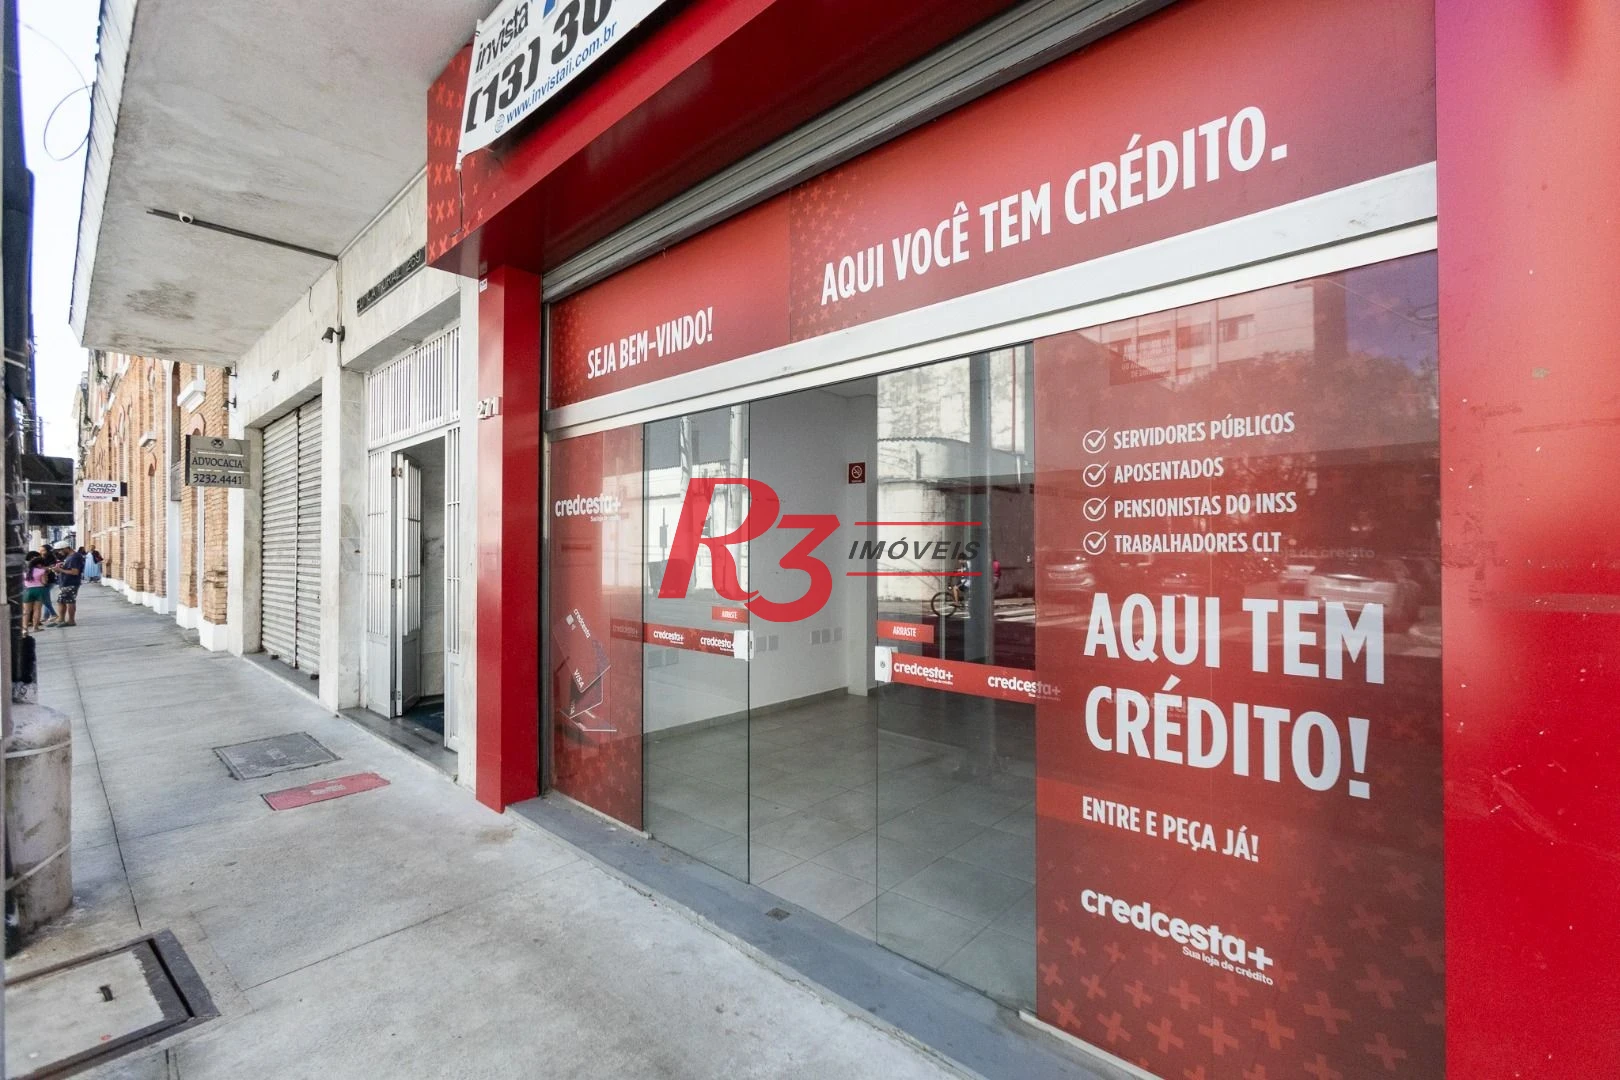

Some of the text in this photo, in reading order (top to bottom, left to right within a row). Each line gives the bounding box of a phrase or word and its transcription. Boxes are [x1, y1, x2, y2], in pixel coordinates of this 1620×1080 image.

[475, 1, 529, 74] invista
[820, 105, 1288, 305] AQUI VOCÊ TEM CRÉDITO.
[587, 306, 713, 379] SEJA BEM-VINDO!
[1113, 411, 1295, 450] SERVIDORES PÚBLICOS
[192, 457, 243, 468] ADVOCACIA
[193, 474, 242, 484] 3232.4441
[1113, 456, 1224, 484] APOSENTADOS
[1114, 491, 1297, 519] PENSIONISTAS DO INSS
[1114, 532, 1248, 553] TRABALHADORES
[1252, 531, 1282, 553] CLT
[892, 625, 917, 637] ARRASTE
[1083, 592, 1385, 684] AQUI TEM
[574, 668, 585, 688] VISA
[1085, 674, 1370, 800] CRÉDITO!
[1082, 795, 1259, 863] ENTRE E PEÇA JÁ!
[1182, 946, 1273, 986] Sua loja de crédito
